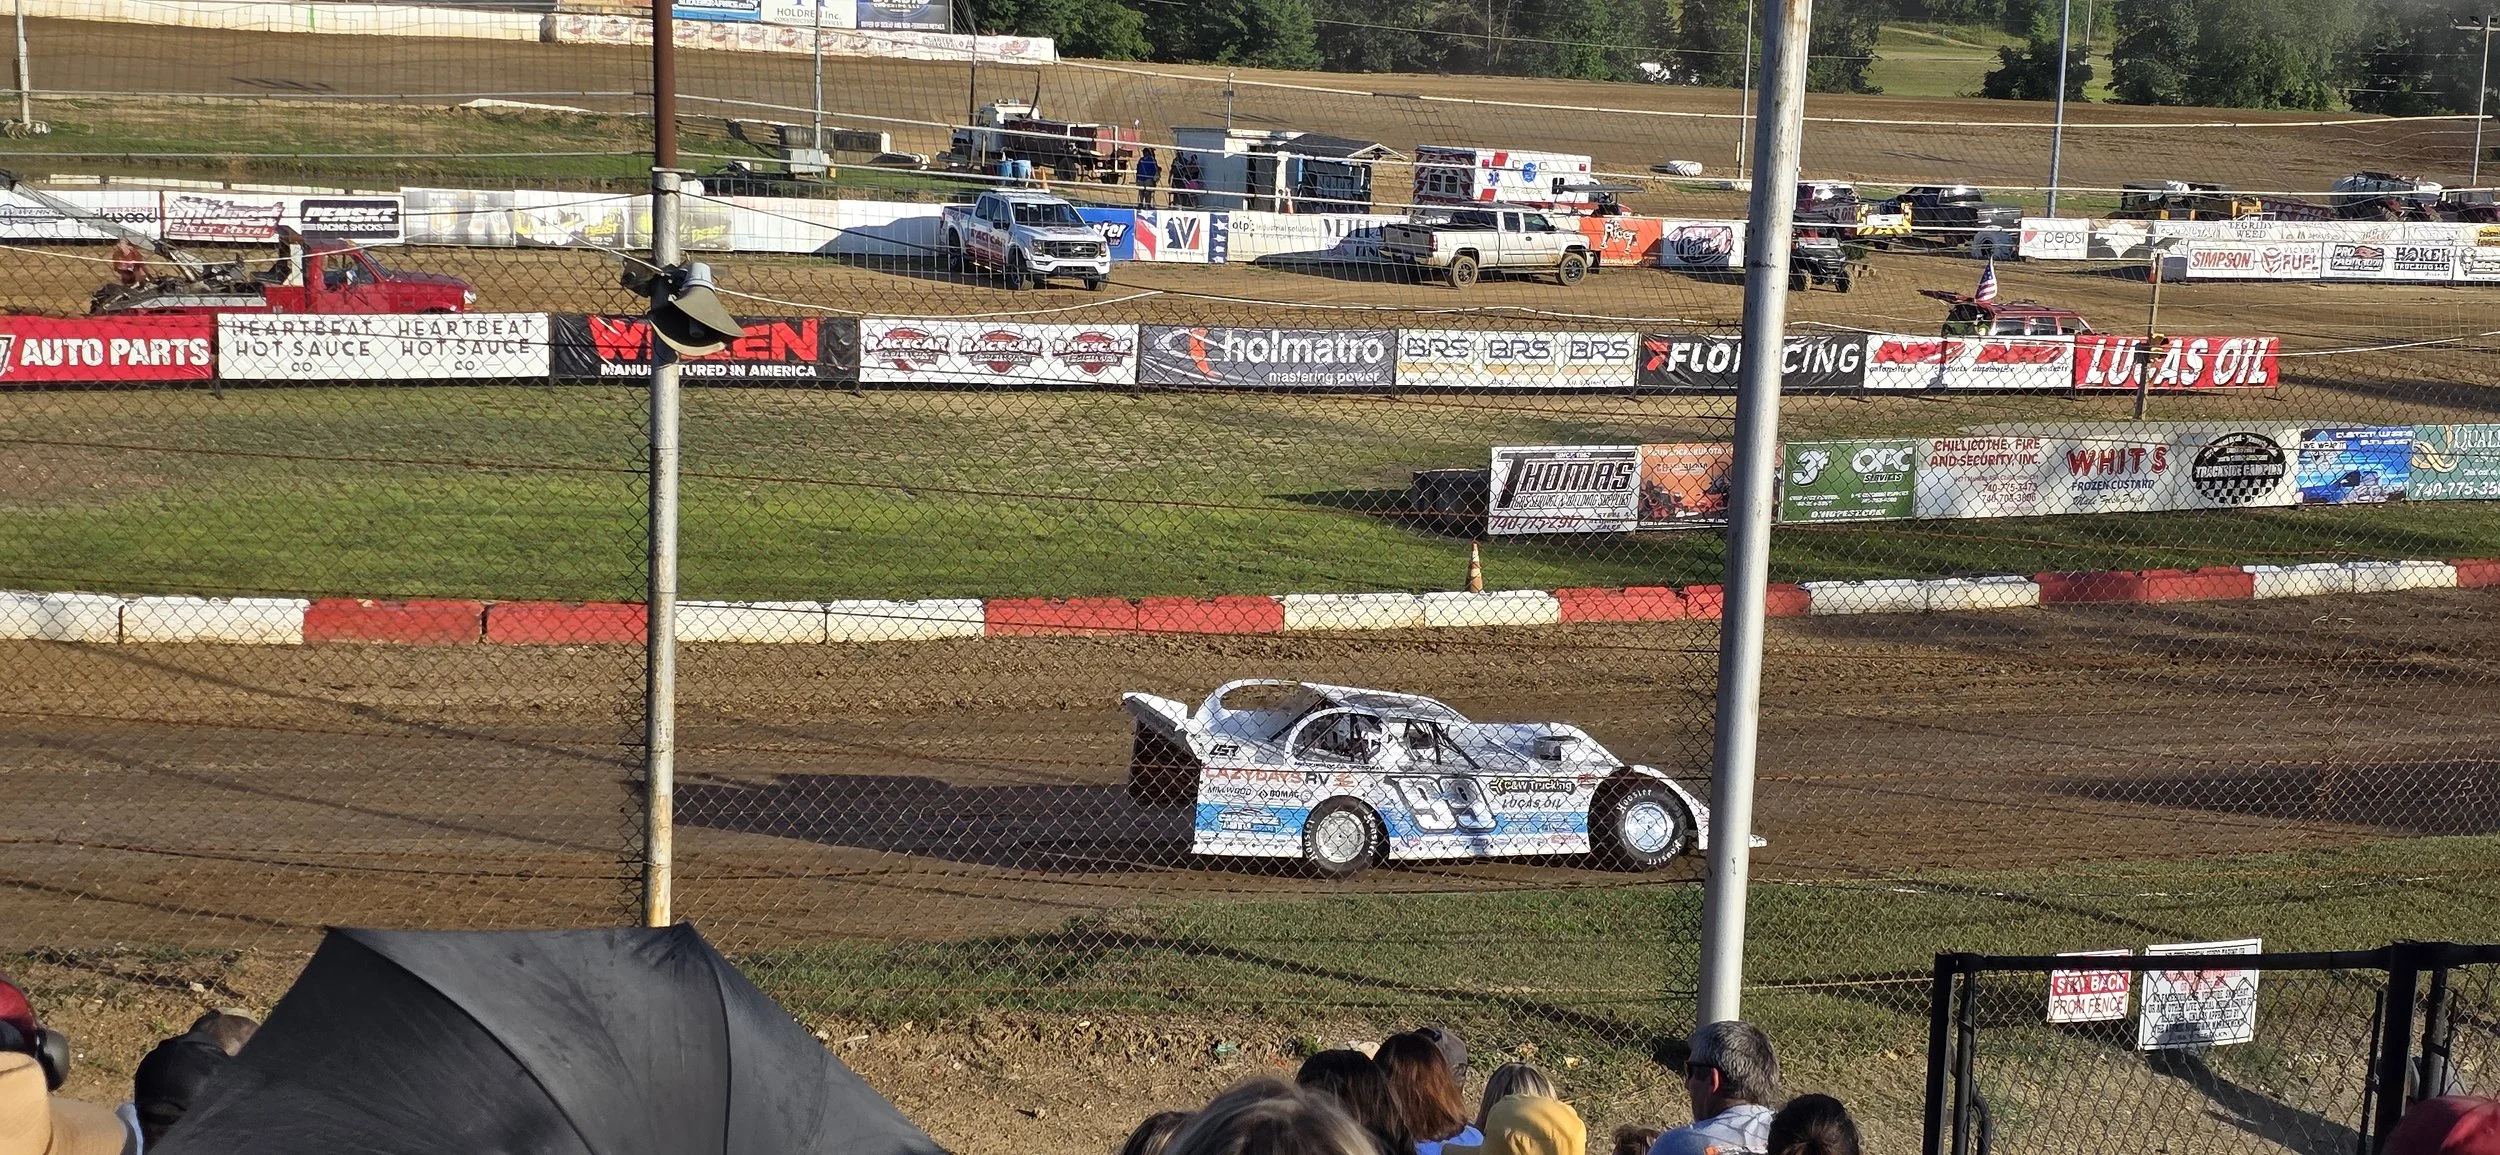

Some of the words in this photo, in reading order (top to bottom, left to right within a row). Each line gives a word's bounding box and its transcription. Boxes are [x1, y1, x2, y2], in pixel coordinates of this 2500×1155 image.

[825, 11, 841, 20] Inc.
[303, 207, 397, 223] PENSKE
[317, 224, 347, 232] RACING
[349, 224, 384, 232] SHOCKS
[2228, 221, 2275, 230] TEGRIDY
[2044, 231, 2085, 249] pepsi
[2235, 229, 2267, 239] WEED
[2192, 251, 2252, 269] SIMPSON
[2335, 246, 2355, 258] PRO
[2394, 263, 2434, 271] TRUCKING
[2435, 263, 2450, 271] LLC
[231, 320, 373, 337] HEARTBEAT
[399, 320, 532, 336] HEARTBEAT
[20, 338, 104, 367] AUTO
[110, 337, 210, 367] PARTS
[236, 340, 283, 357] HOT
[293, 340, 371, 357] SAUCE
[401, 340, 447, 357] HOT
[456, 338, 530, 356] SAUCE
[1223, 329, 1385, 364] holmatro
[1405, 337, 1470, 358] BRS
[1489, 339, 1551, 360] BRS
[1570, 340, 1630, 360] BRS
[454, 360, 479, 371] CO.
[1667, 342, 1860, 374] FLOCING
[2212, 337, 2270, 386] OIL
[291, 361, 317, 372] CO.
[600, 363, 724, 377] MANUTURED
[727, 363, 747, 377] IN
[749, 364, 817, 377] AMERICA
[1269, 371, 1335, 385] mastering
[1337, 370, 1380, 384] power
[1934, 438, 2008, 453] CHILLICOTHE
[2015, 438, 2041, 450] FIRE
[1930, 455, 1957, 467] AND
[1961, 454, 2015, 467] SECURITY,
[2018, 453, 2041, 465] INC.
[2195, 464, 2243, 478] TRACKSIDE
[1494, 451, 1637, 511] THOMAS
[2071, 480, 2109, 492] FROZEN
[2111, 479, 2155, 490] CUSTARD
[1204, 767, 1303, 784] LAZYDAYS
[1305, 771, 1331, 785] RV
[1504, 779, 1529, 791] C&W
[1530, 779, 1573, 792] Trucking
[1385, 775, 1499, 834] 99
[1502, 799, 1541, 809] LUCAS
[1544, 798, 1564, 808] OIL
[2056, 976, 2086, 994] STAY
[2090, 973, 2126, 992] BACK
[2088, 995, 2125, 1014] FENCE
